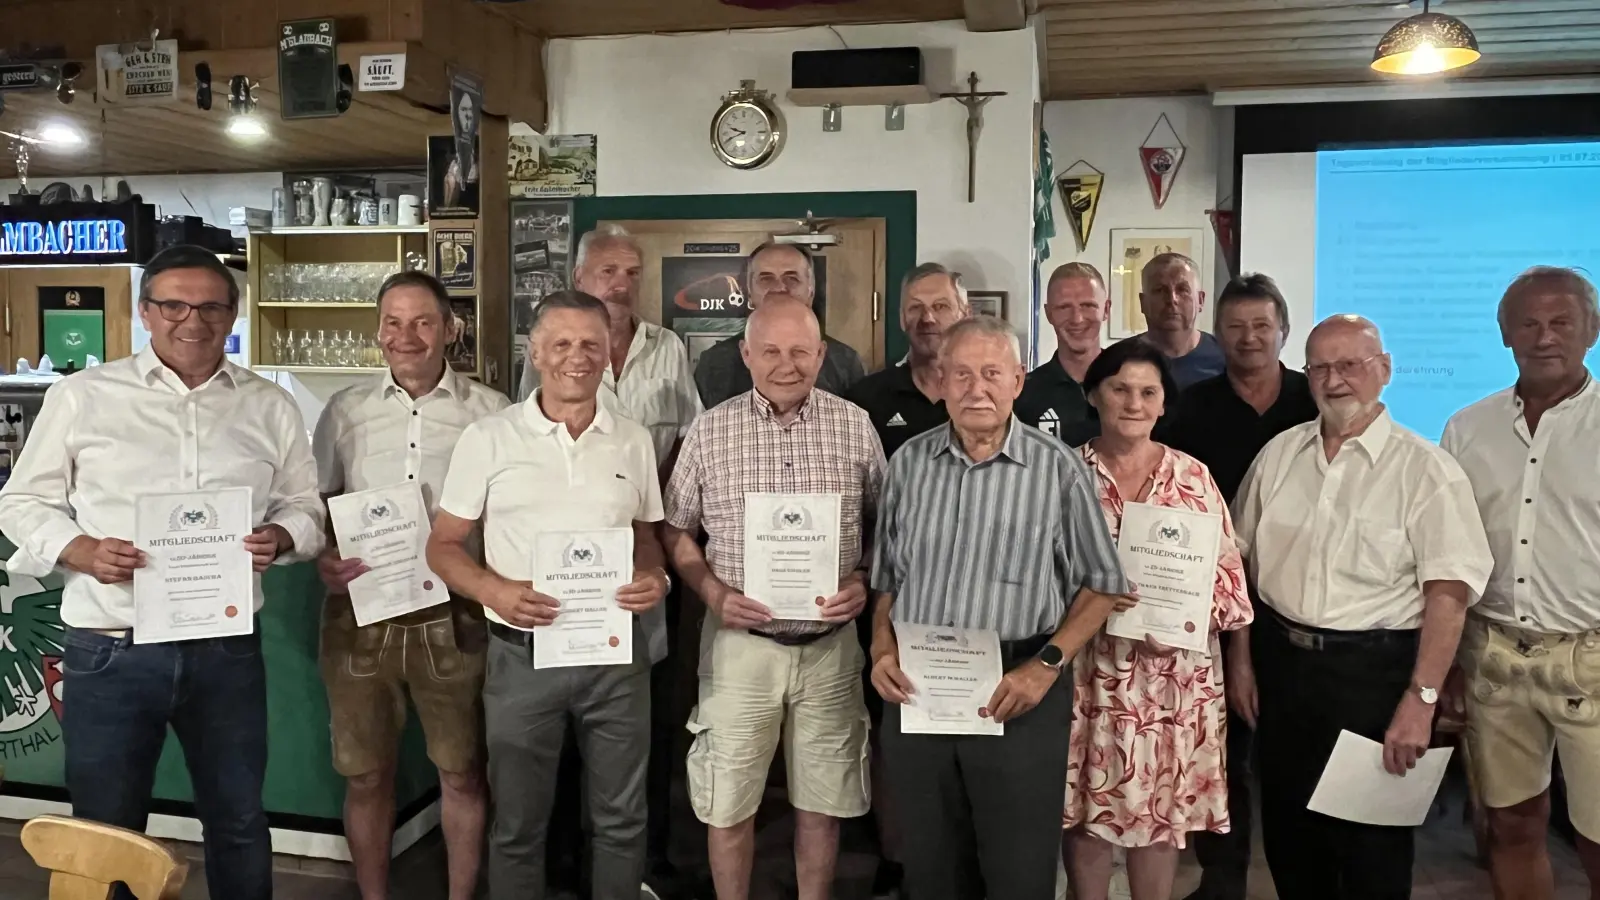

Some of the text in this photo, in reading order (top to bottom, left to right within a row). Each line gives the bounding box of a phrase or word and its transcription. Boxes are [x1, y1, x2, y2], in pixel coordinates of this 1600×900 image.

[700, 299, 725, 311] DJK
[149, 534, 237, 548] MITGLIEDSCHAFT
[756, 535, 828, 543] MITGLIEDSCHAFT
[1130, 545, 1205, 563] MITGLIEDSCHAFT
[545, 571, 619, 581] MITGLIEDSCHAFT
